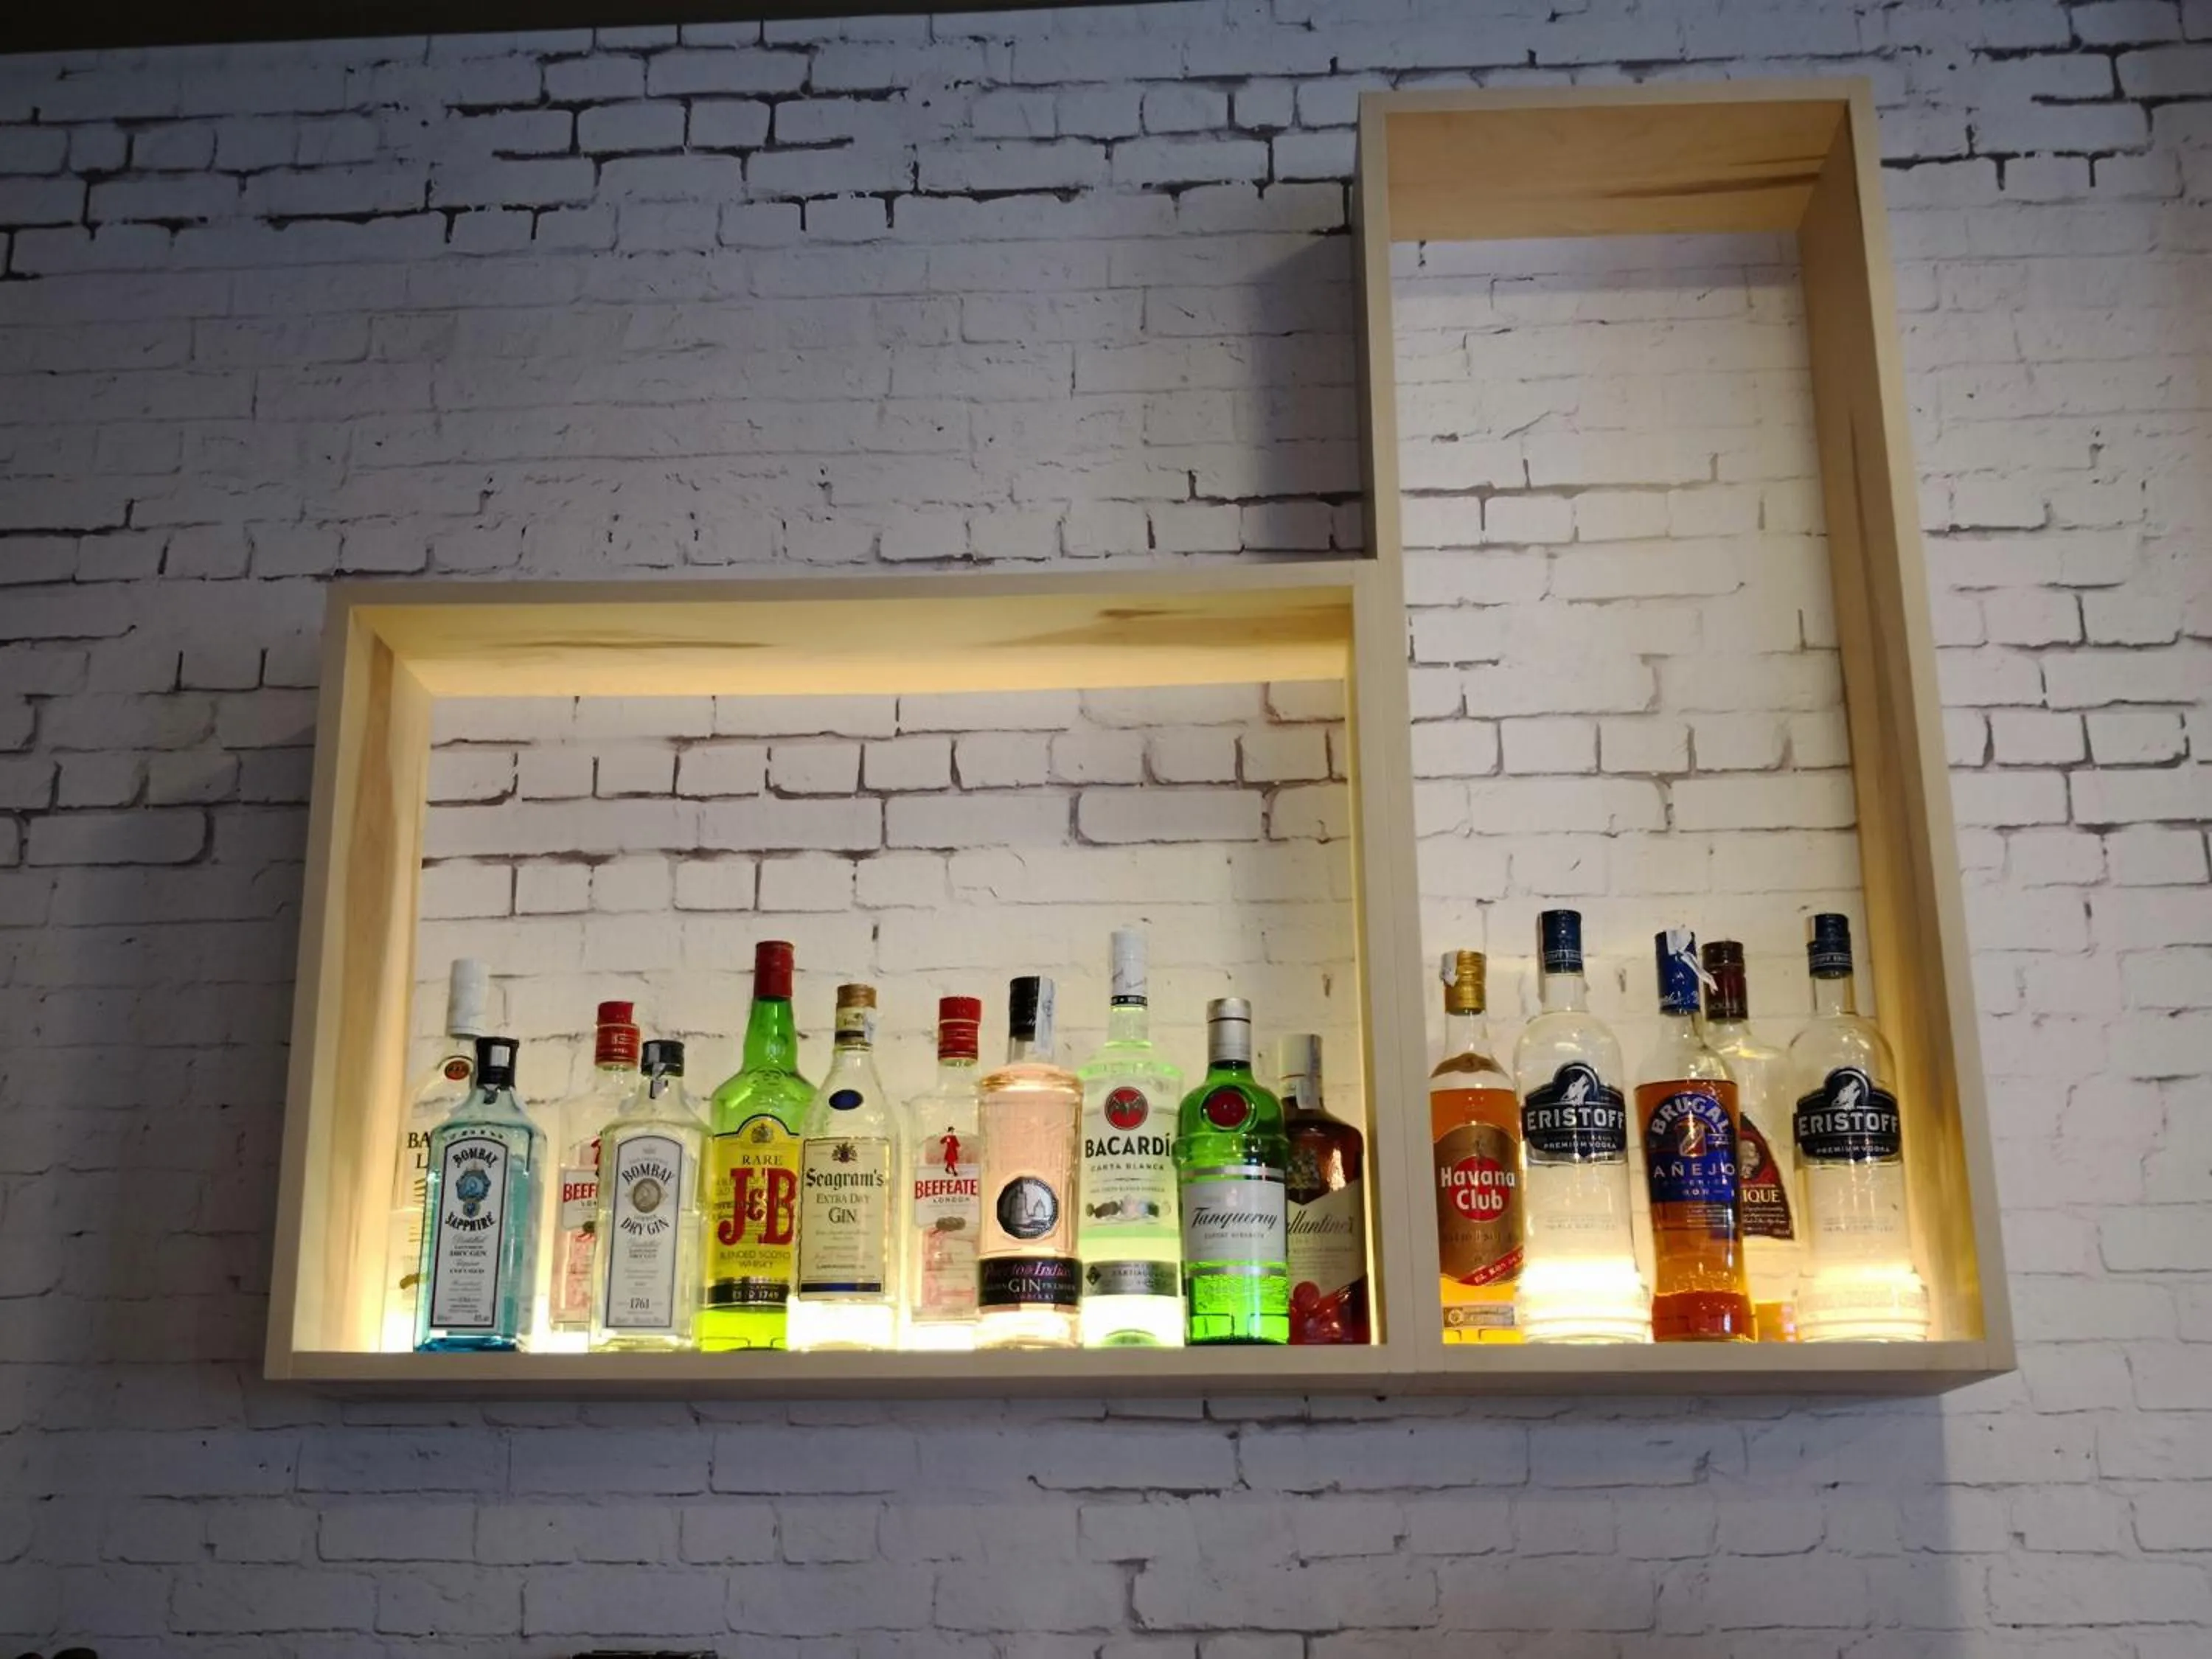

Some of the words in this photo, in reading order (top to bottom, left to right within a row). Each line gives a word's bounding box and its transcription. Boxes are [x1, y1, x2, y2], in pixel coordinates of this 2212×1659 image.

[1526, 1107, 1624, 1131] ERISTOFF
[1652, 1096, 1729, 1135] BRUGAL
[1798, 1112, 1898, 1136] ERISTOFF
[1085, 1132, 1170, 1158] BACARDÍ
[1544, 1141, 1587, 1150] PREMIUM
[452, 1147, 499, 1169] BOMBAY
[742, 1154, 783, 1166] RARE
[622, 1162, 674, 1186] BOMBAY
[805, 1167, 885, 1190] Seagram's
[1440, 1166, 1516, 1188] Havana
[1653, 1160, 1736, 1179] AÑEJO
[563, 1182, 599, 1203] BEEF
[915, 1179, 978, 1200] BEEFEATE
[1456, 1189, 1503, 1211] Club
[1742, 1189, 1781, 1203] IQUE
[717, 1167, 798, 1245] J&B
[828, 1207, 857, 1224] GIN
[445, 1211, 497, 1231] SAPPHIRE
[620, 1217, 644, 1236] DRY
[647, 1217, 670, 1235] GIN
[1191, 1207, 1278, 1230] Tanqueray
[1007, 1278, 1041, 1293] GIN
[628, 1297, 650, 1310] 1761
